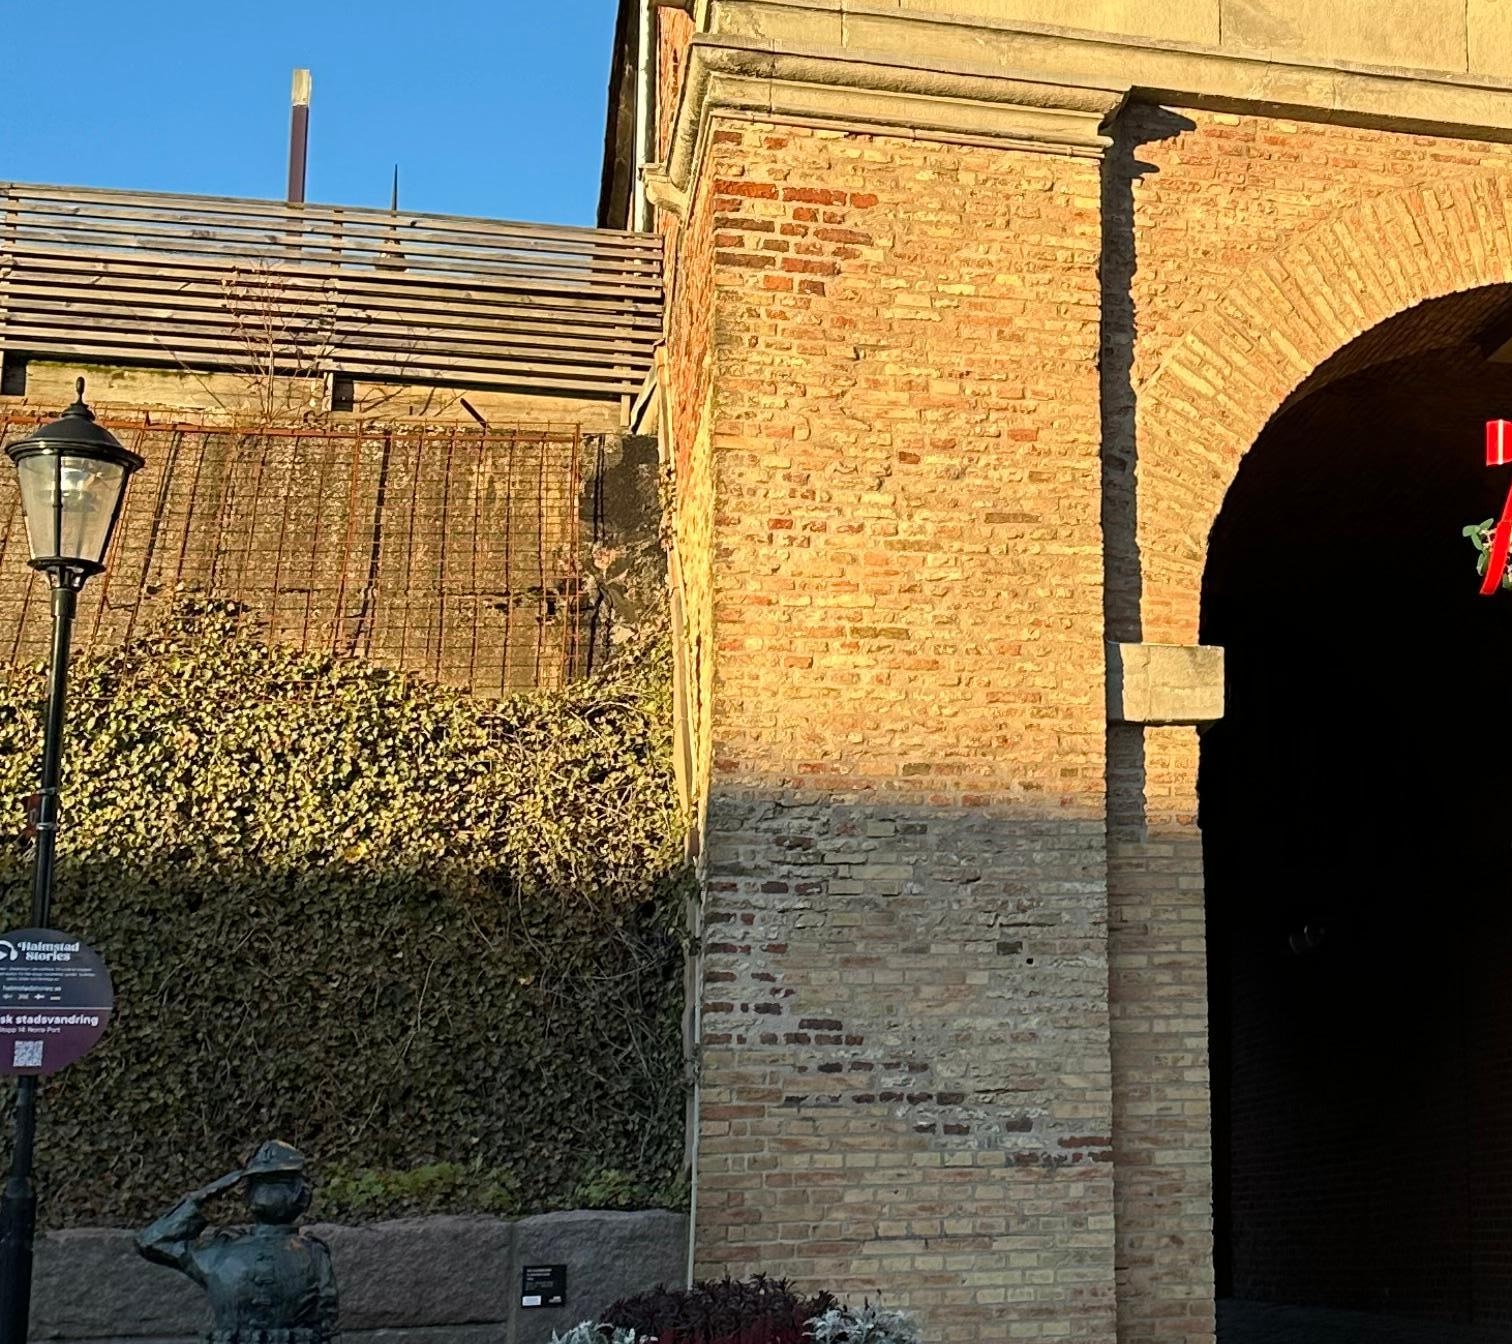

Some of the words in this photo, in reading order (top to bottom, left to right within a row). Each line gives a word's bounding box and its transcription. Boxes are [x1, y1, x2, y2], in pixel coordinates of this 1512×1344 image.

[18, 942, 80, 952] Halmstad
[25, 952, 71, 961] Stories
[15, 1014, 99, 1027] stadsvandring
